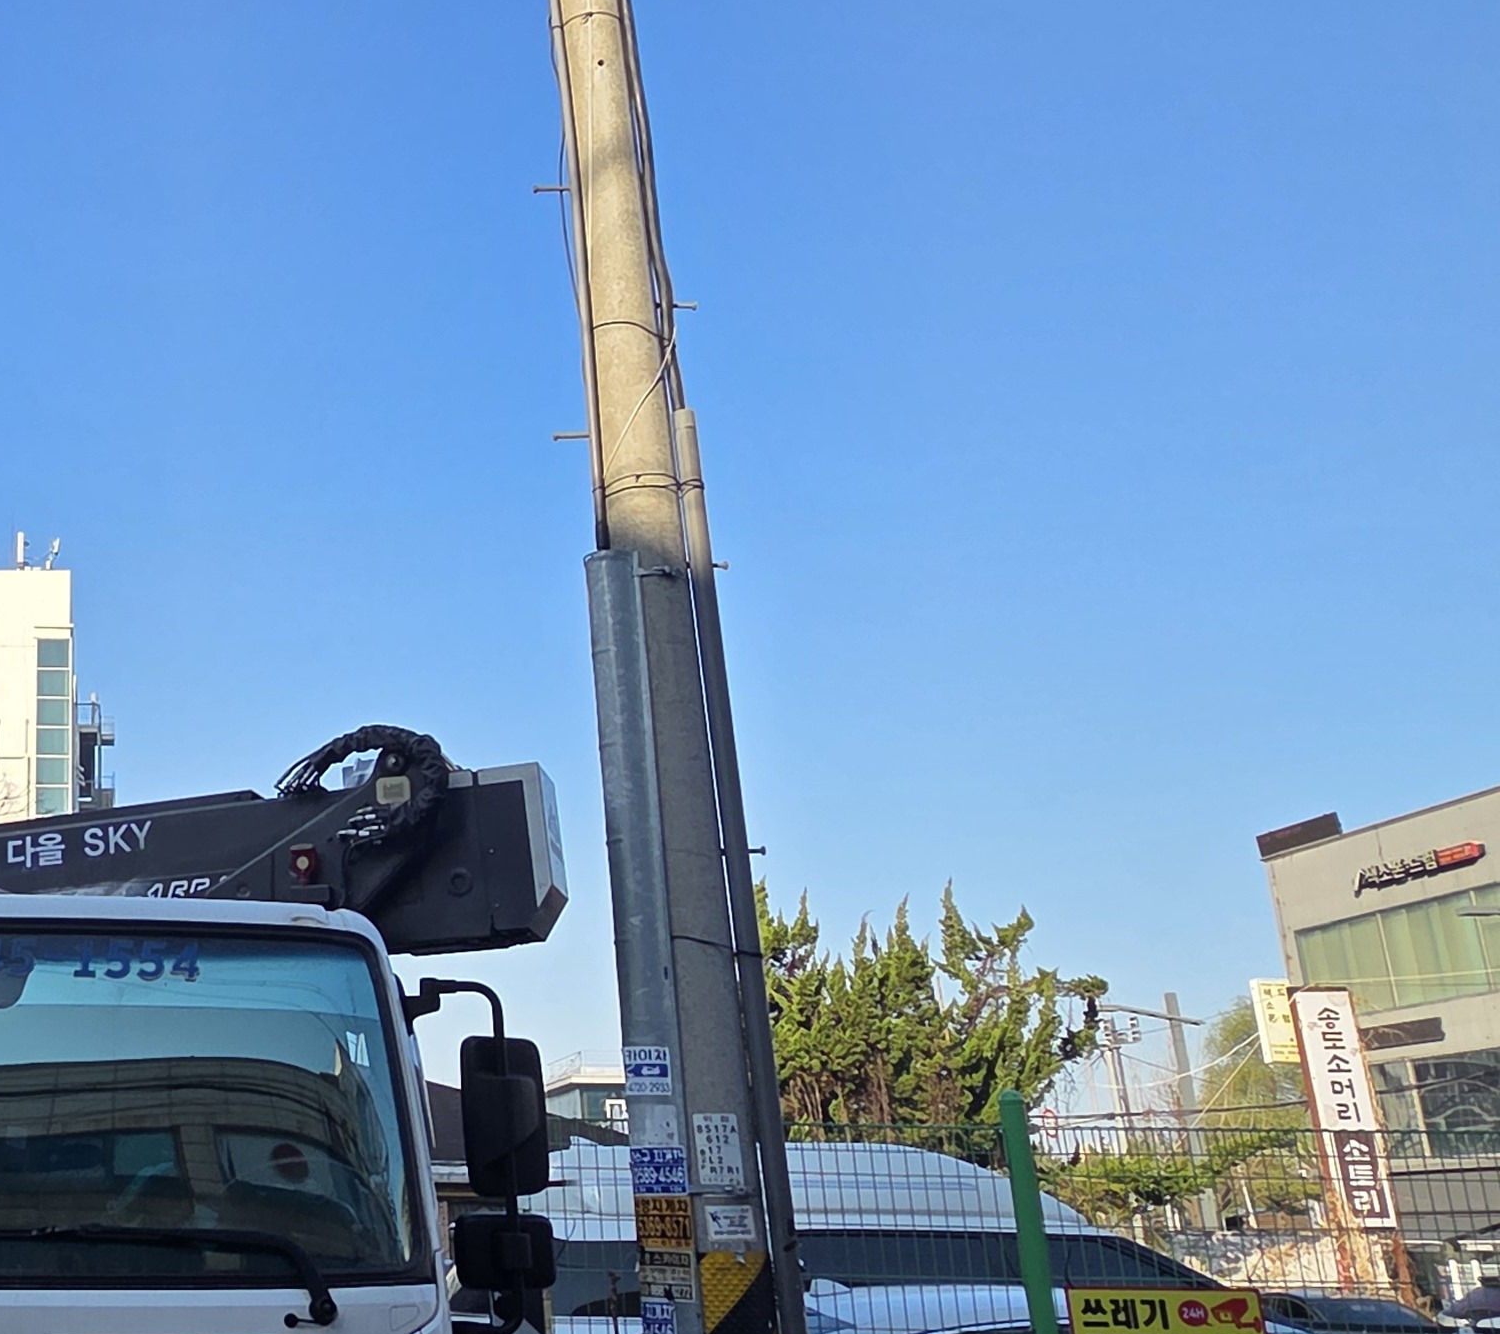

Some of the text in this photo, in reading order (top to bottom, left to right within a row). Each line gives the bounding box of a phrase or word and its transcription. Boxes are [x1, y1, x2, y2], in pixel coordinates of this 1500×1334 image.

[7, 821, 152, 868] 다올 SKY
[1080, 1298, 1205, 1330] 쓰레기 24H
